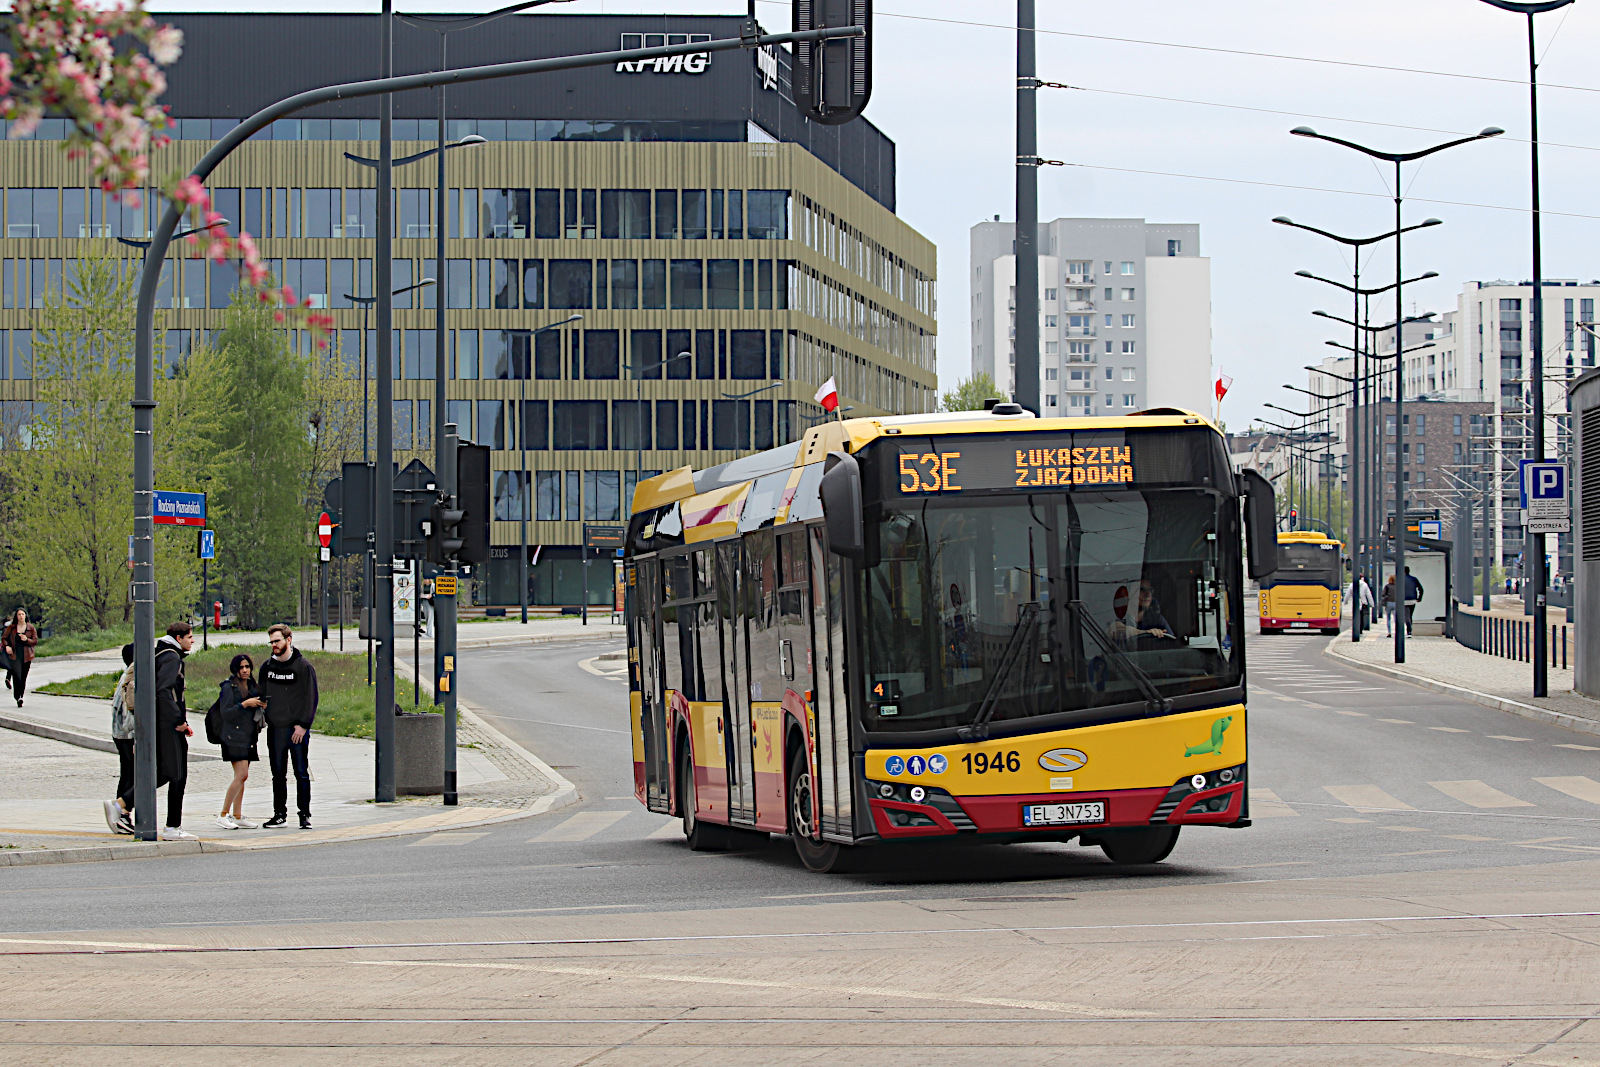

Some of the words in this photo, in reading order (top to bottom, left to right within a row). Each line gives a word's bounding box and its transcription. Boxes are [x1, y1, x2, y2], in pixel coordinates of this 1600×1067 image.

[899, 451, 962, 492] 53E
[1015, 445, 1131, 467] ŁUKASZEW
[1015, 465, 1134, 486] ZJAZDOWA
[1539, 469, 1557, 495] P
[158, 499, 176, 516] Rodziny
[176, 500, 200, 514] Poznańskich
[490, 549, 508, 558] EXUS
[874, 683, 884, 696] 4
[961, 750, 1021, 775] 1946
[1033, 807, 1051, 821] EL
[1057, 804, 1101, 820] 3N753
